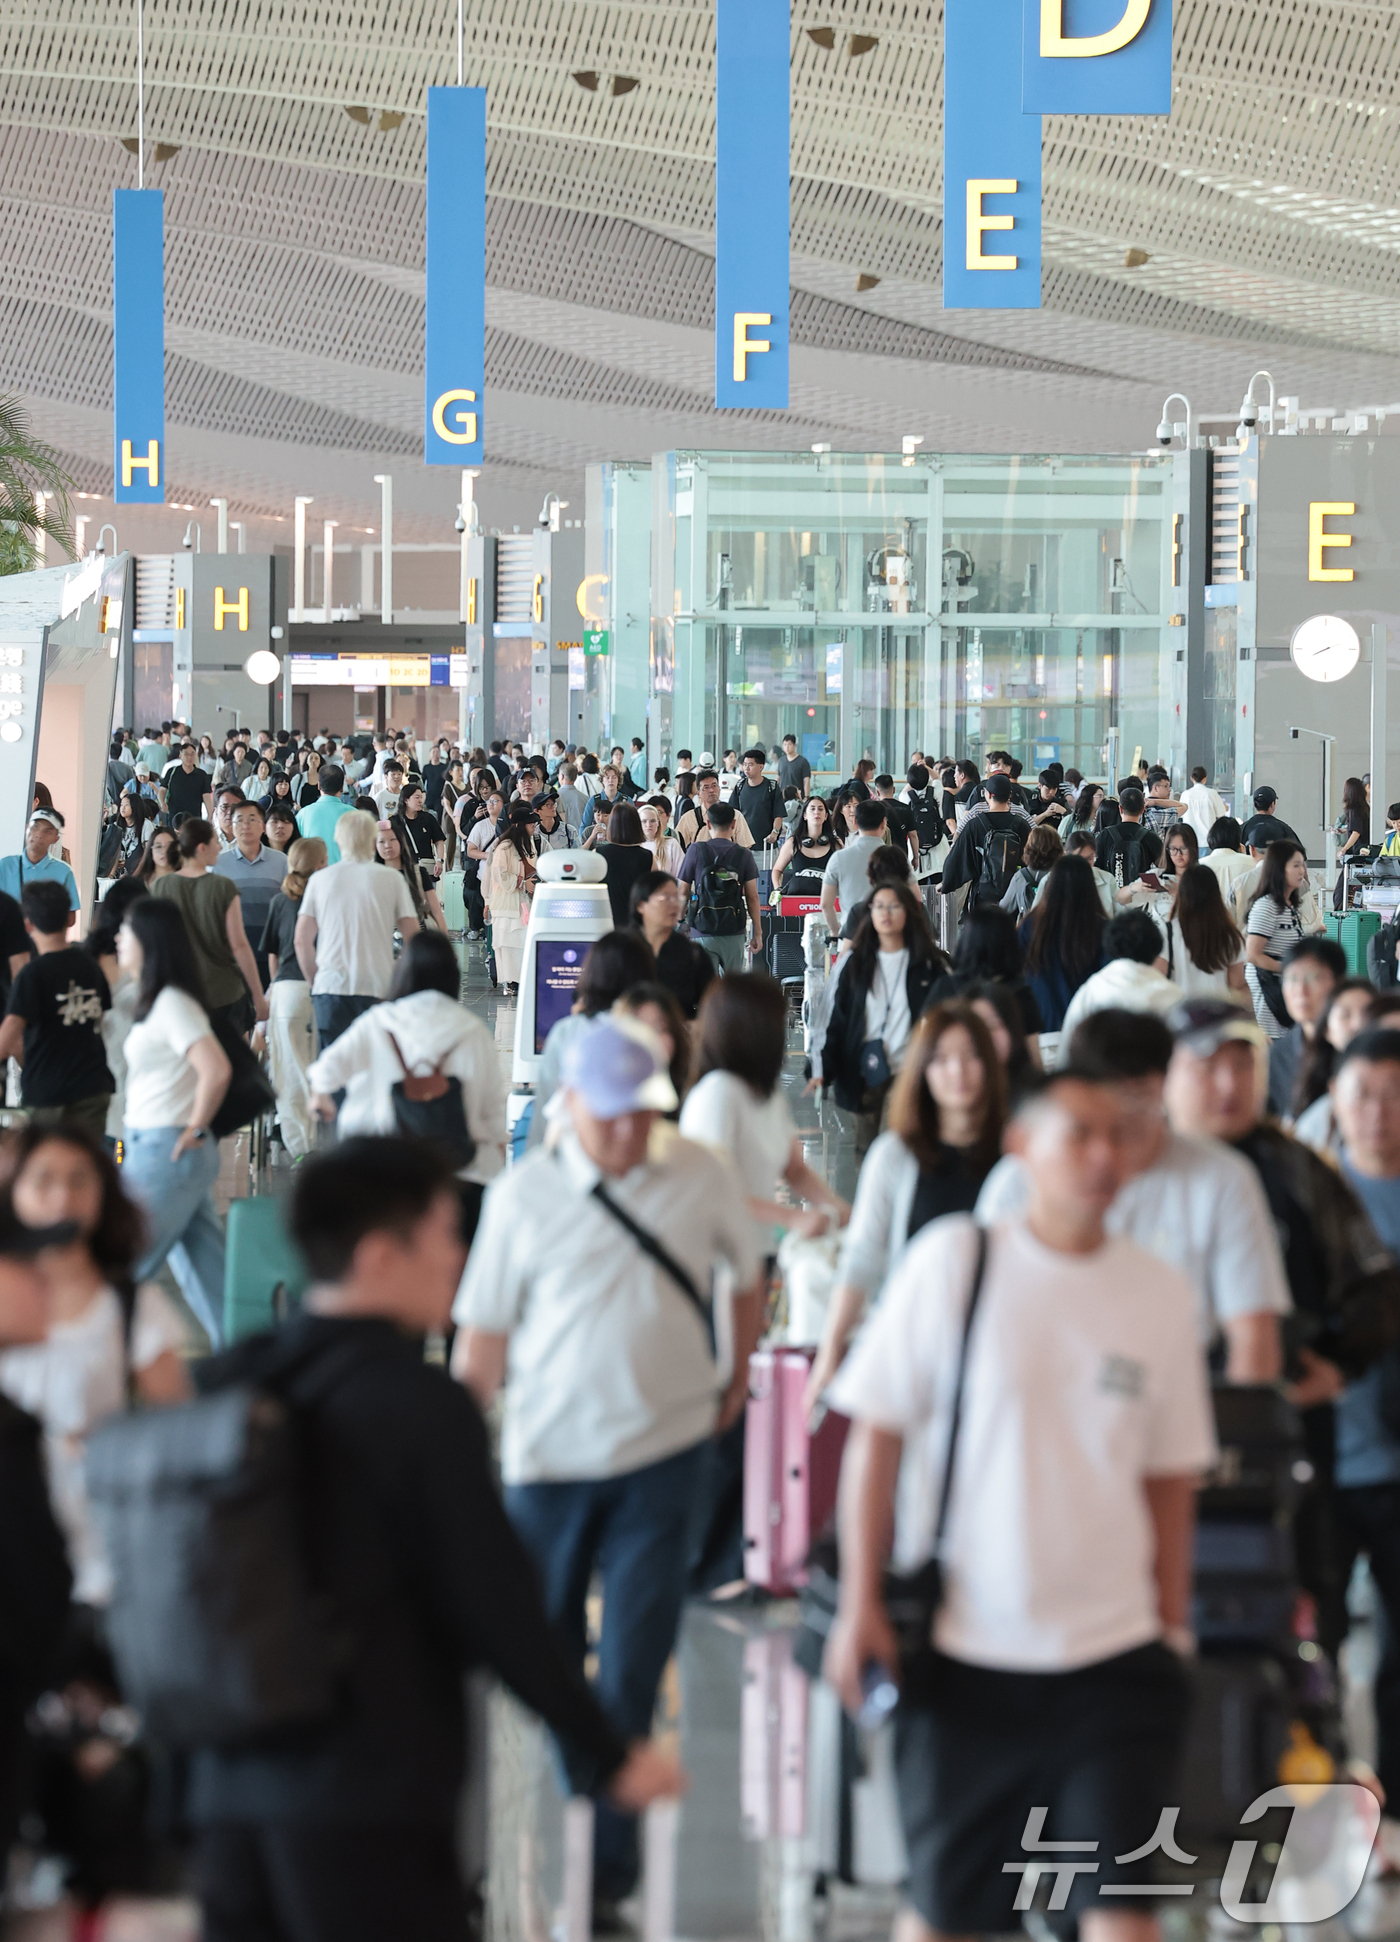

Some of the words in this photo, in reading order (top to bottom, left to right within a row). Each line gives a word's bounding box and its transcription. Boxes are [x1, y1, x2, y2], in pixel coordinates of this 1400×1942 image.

[966, 179, 1018, 270] E
[733, 313, 772, 381] F
[432, 389, 477, 444] G
[121, 440, 159, 487] H
[1308, 501, 1356, 582] E
[213, 586, 250, 631] H
